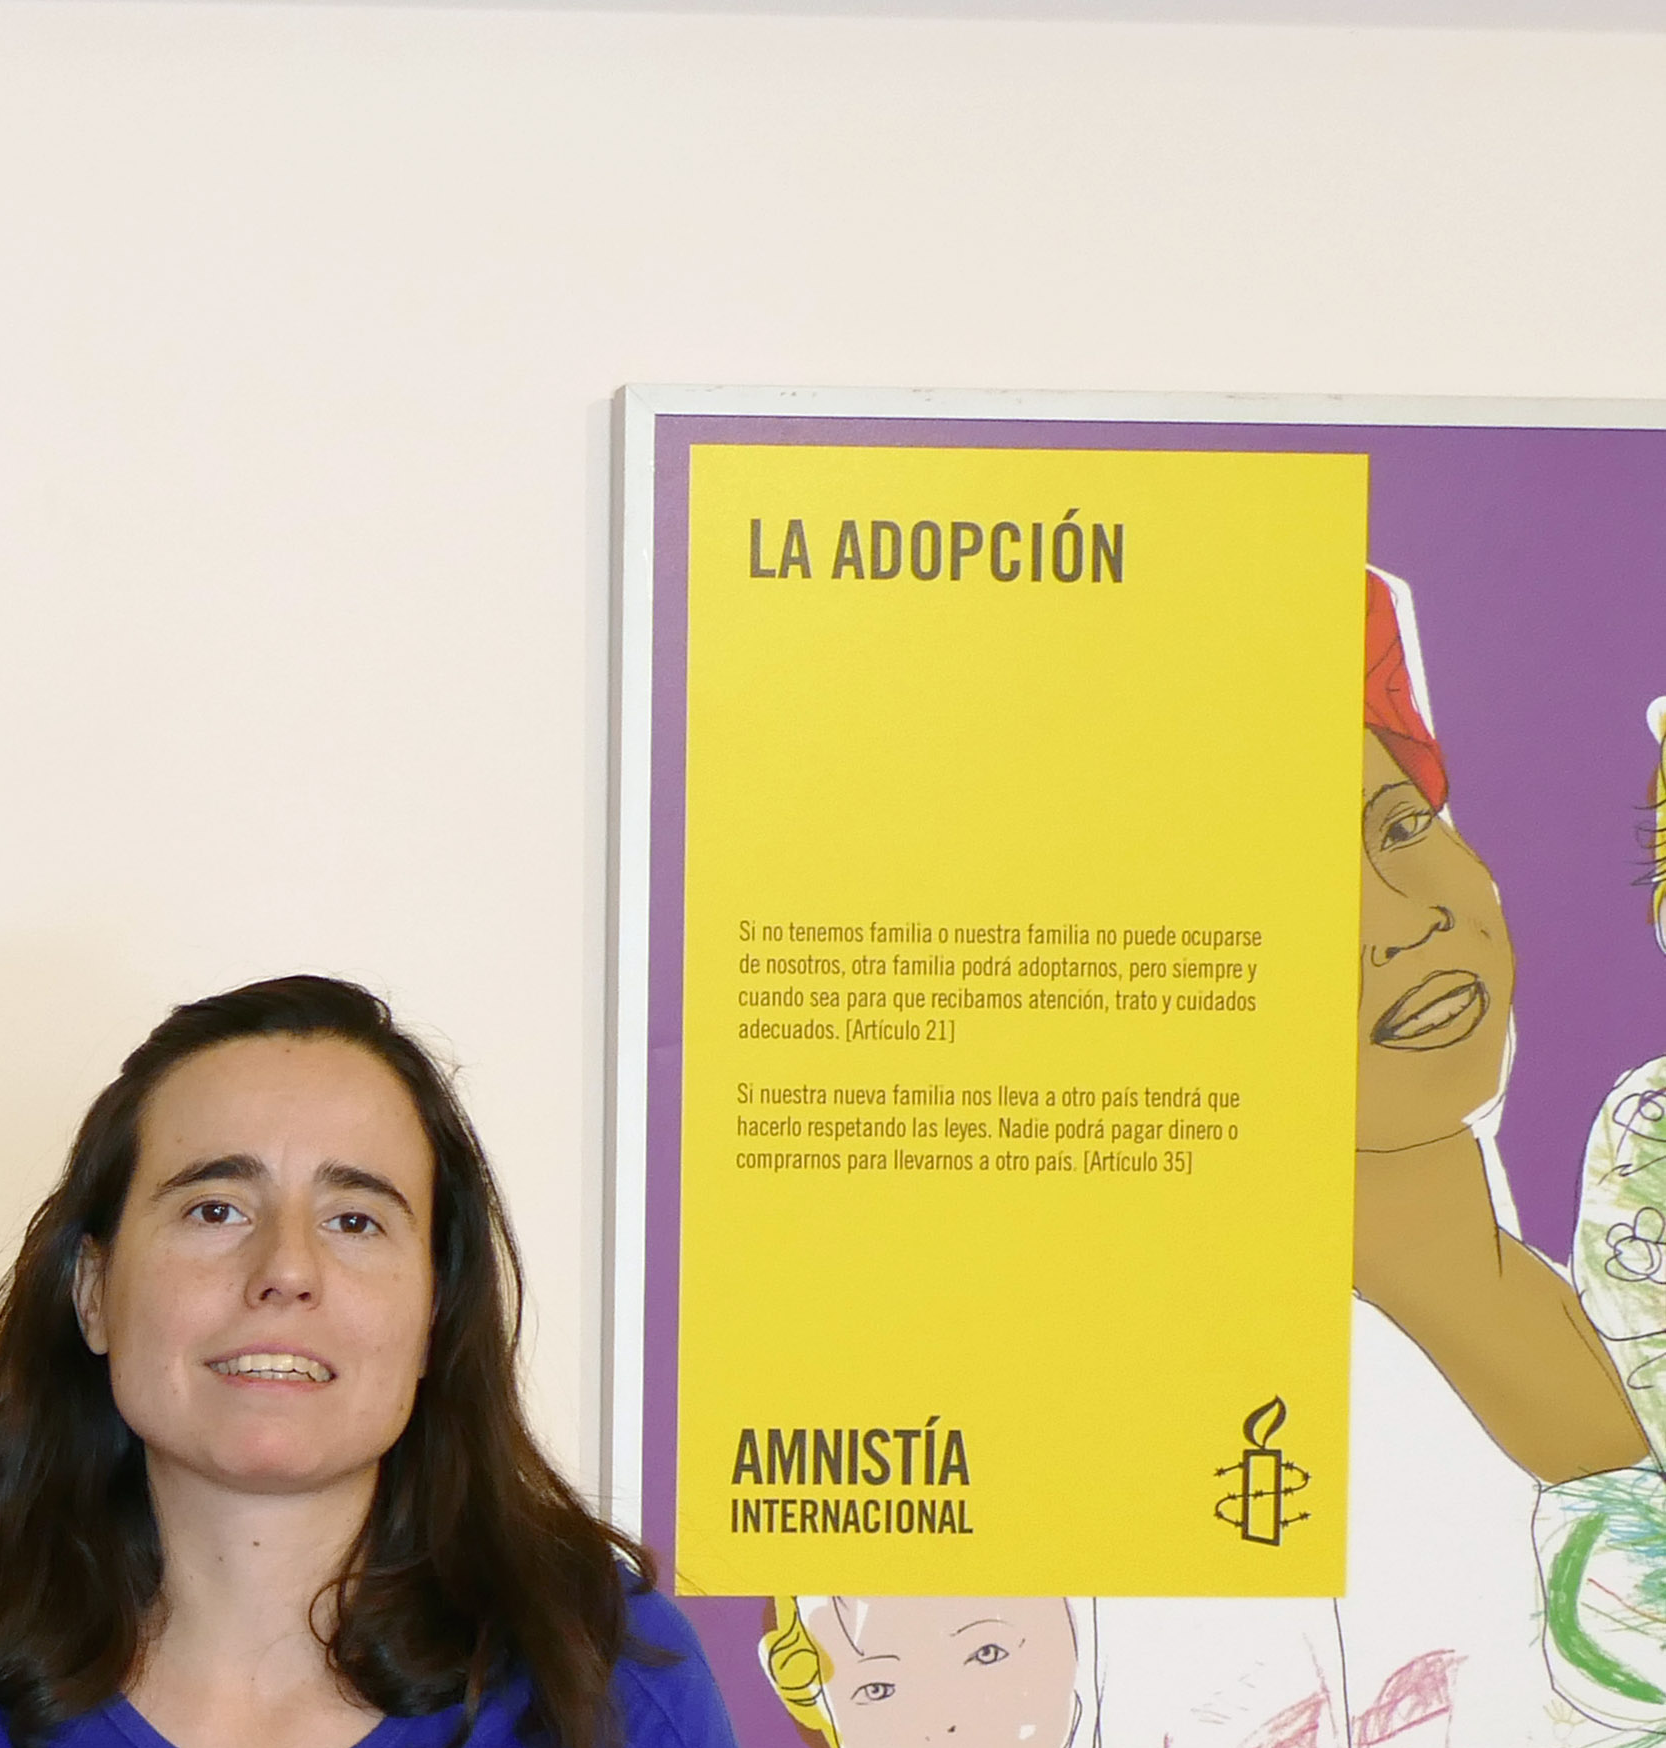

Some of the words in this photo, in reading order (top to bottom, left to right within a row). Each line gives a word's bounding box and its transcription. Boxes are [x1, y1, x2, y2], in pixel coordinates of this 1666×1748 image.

[750, 519, 811, 579] LA
[831, 508, 1123, 583] ADOPCIÓN
[740, 921, 755, 941] Si
[763, 926, 783, 941] no
[789, 922, 863, 942] tenemos
[870, 922, 931, 943] familia
[939, 928, 948, 943] o
[955, 924, 1020, 944] nuestra
[1027, 923, 1089, 944] familia
[1097, 929, 1117, 945] no
[1124, 925, 1176, 950] puede
[1182, 930, 1262, 950] ocuparse
[739, 953, 760, 974] de
[767, 954, 845, 977] nosotros,
[852, 955, 886, 975] otra
[892, 954, 954, 976] familia
[963, 956, 1011, 980] podrá
[1018, 956, 1122, 981] adoptarnos,
[1130, 962, 1166, 982] pero
[1173, 959, 1242, 983] siempre
[1247, 964, 1257, 983] y
[739, 986, 804, 1007] cuando
[810, 992, 839, 1007] sea
[847, 992, 886, 1011] para
[893, 992, 925, 1012] que
[932, 988, 1022, 1009] recibamos
[1029, 989, 1109, 1012] atención,
[1116, 990, 1157, 1010] trato
[1162, 995, 1171, 1014] y
[1177, 990, 1256, 1011] cuidados
[739, 1018, 839, 1039] adecuados.
[846, 1019, 920, 1042] [Artículo
[926, 1020, 954, 1043] 21]
[737, 1083, 753, 1103] Si
[761, 1084, 826, 1104] nuestra
[834, 1089, 885, 1105] nueva
[893, 1084, 954, 1105] familia
[962, 1090, 991, 1106] nos
[999, 1085, 1038, 1106] lleva
[1046, 1091, 1055, 1106] a
[1062, 1087, 1095, 1107] otro
[1102, 1087, 1138, 1111] país
[1144, 1087, 1201, 1108] tendrá
[1208, 1092, 1240, 1112] que
[738, 1115, 801, 1137] hacerlo
[808, 1117, 906, 1141] respetando
[913, 1117, 938, 1137] las
[945, 1117, 991, 1142] leyes.
[999, 1118, 1049, 1139] Nadie
[1056, 1118, 1104, 1143] podrá
[1112, 1124, 1164, 1144] pagar
[1169, 1119, 1222, 1140] dinero
[1228, 1125, 1238, 1140] o
[736, 1153, 841, 1173] comprarnos
[848, 1154, 886, 1174] para
[894, 1149, 973, 1170] llevarnos
[979, 1155, 989, 1170] a
[996, 1151, 1029, 1171] otro
[1036, 1150, 1077, 1175] país.
[1084, 1151, 1157, 1174] [Artículo
[1163, 1151, 1192, 1175] 35]
[731, 1416, 969, 1485] AMNISTÍA
[732, 1499, 973, 1533] INTERNACIONAL
